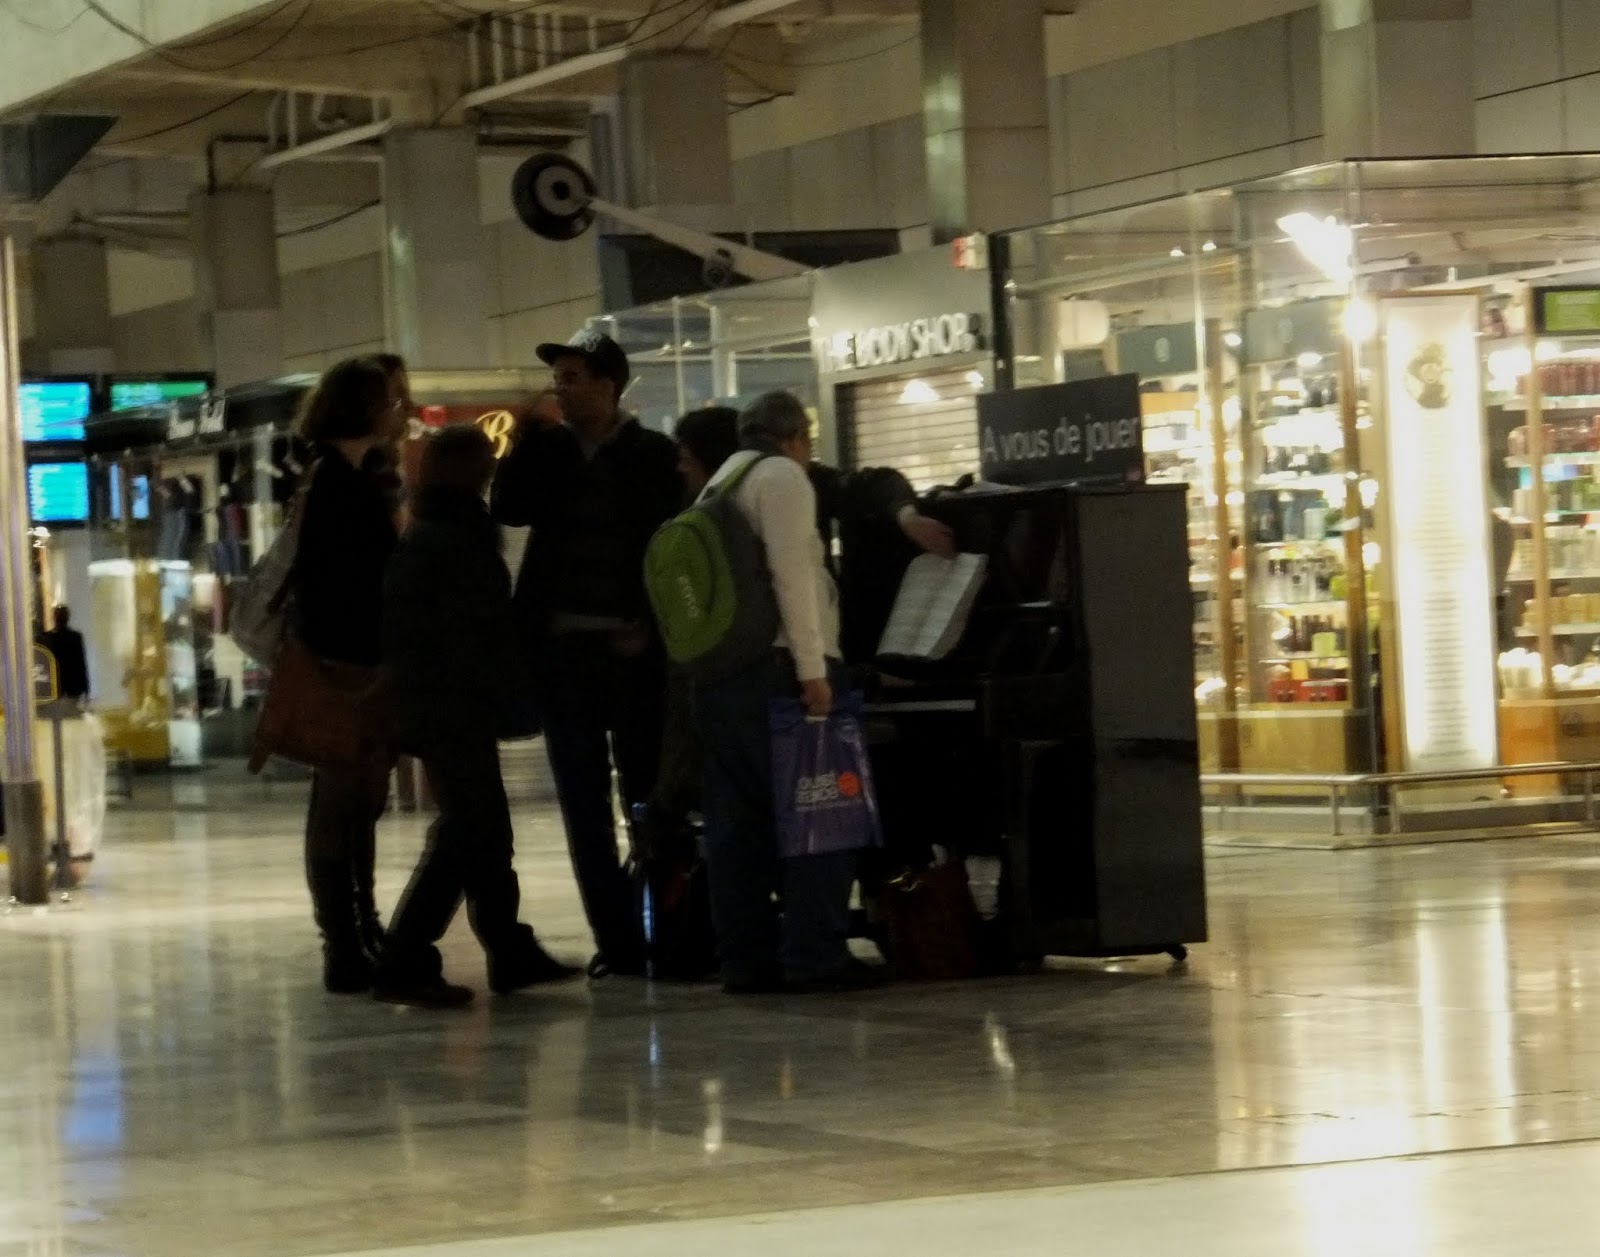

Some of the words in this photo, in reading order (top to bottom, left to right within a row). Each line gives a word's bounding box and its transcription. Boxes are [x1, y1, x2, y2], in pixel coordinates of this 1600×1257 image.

[815, 331, 855, 373] THE
[856, 321, 911, 369] BODY
[911, 312, 969, 359] SHOP
[1000, 428, 1050, 461] vous
[1053, 416, 1081, 456] de
[1085, 412, 1140, 463] jouer
